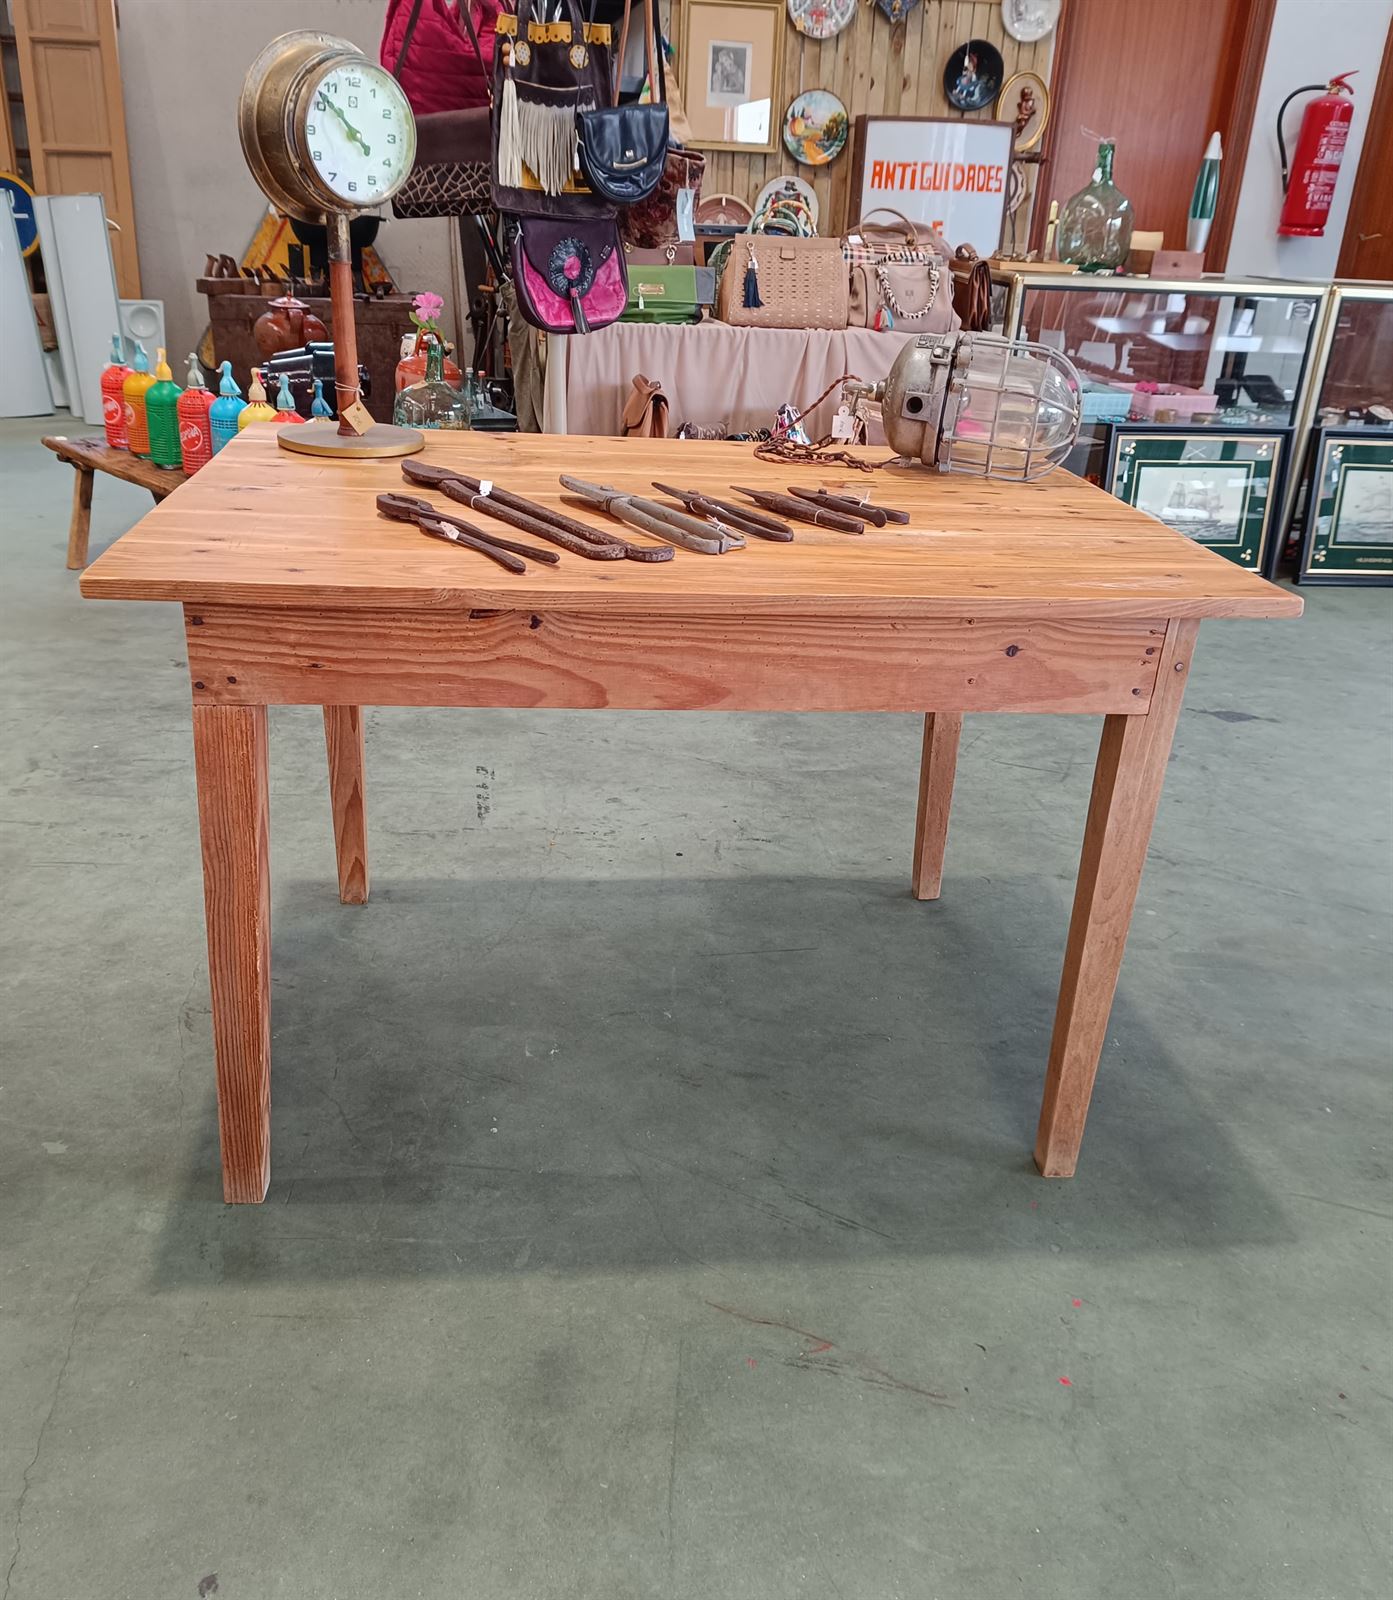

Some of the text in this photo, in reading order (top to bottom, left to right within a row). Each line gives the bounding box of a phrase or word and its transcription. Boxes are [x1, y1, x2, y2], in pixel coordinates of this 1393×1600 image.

[324, 81, 338, 93] 11
[345, 76, 361, 88] 12
[369, 88, 376, 99] 1
[382, 108, 392, 120] 2
[307, 124, 316, 135] 9
[386, 133, 396, 144] 3
[313, 150, 322, 161] 8
[382, 158, 392, 168] 4
[328, 171, 337, 182] 7
[367, 175, 377, 186] 5
[348, 181, 357, 192] 6
